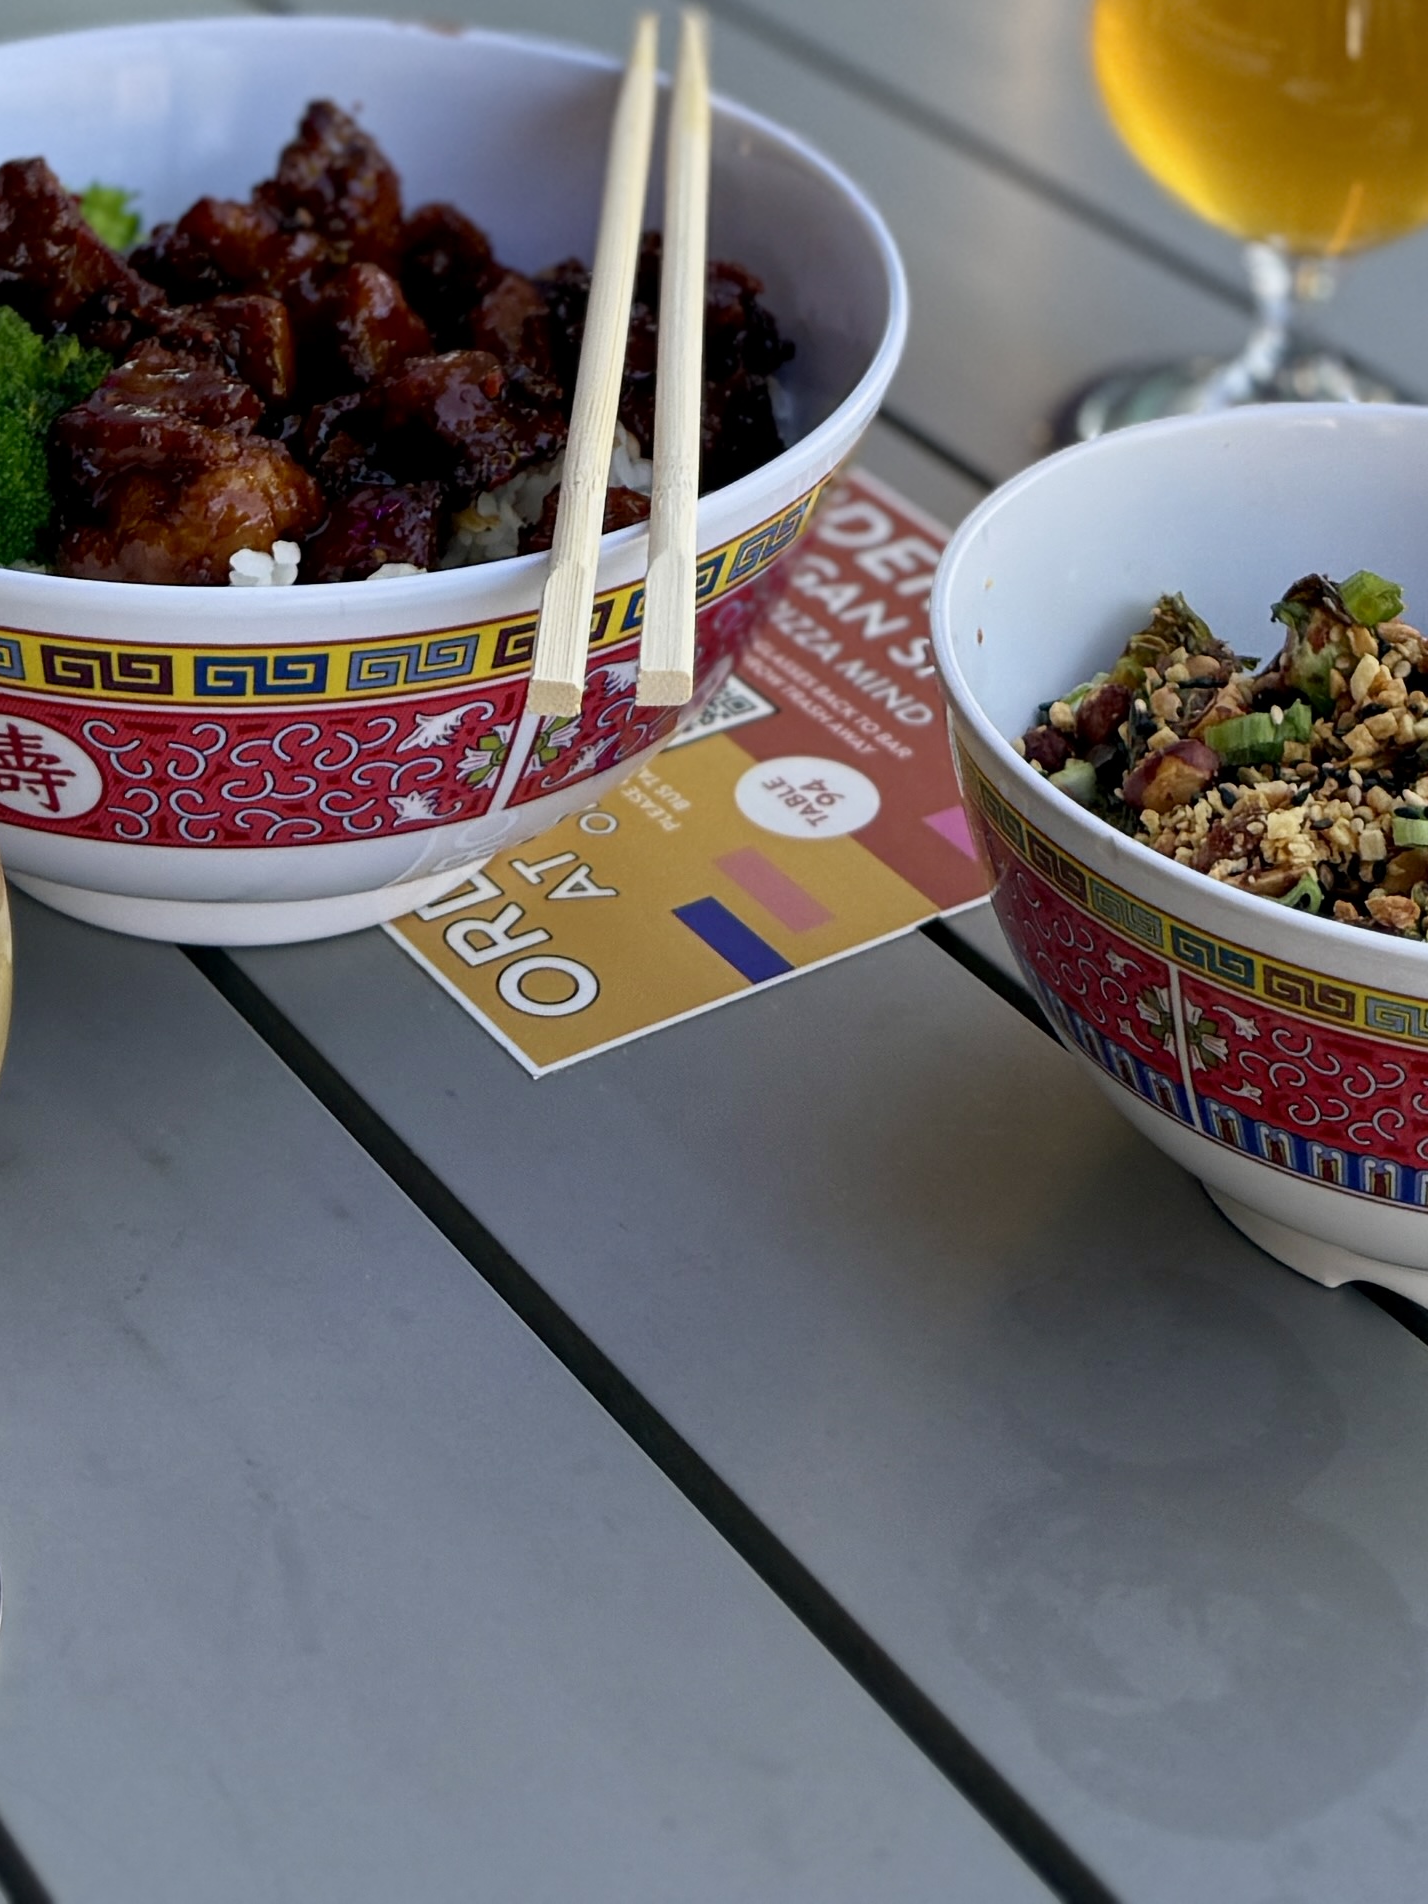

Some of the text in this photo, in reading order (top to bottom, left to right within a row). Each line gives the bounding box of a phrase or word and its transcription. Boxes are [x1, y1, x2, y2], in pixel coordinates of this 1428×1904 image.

[791, 553, 910, 640] GAN
[783, 684, 832, 723] TRASH
[825, 715, 879, 753] AWAY
[834, 658, 935, 726] MIND
[814, 680, 860, 722] BACK
[853, 707, 881, 734] TO
[874, 729, 914, 760] BAR
[621, 784, 682, 833] PLEASE
[652, 783, 692, 812] BUS
[761, 775, 829, 829] TABLE
[799, 777, 846, 808] 94
[509, 850, 620, 901] AT
